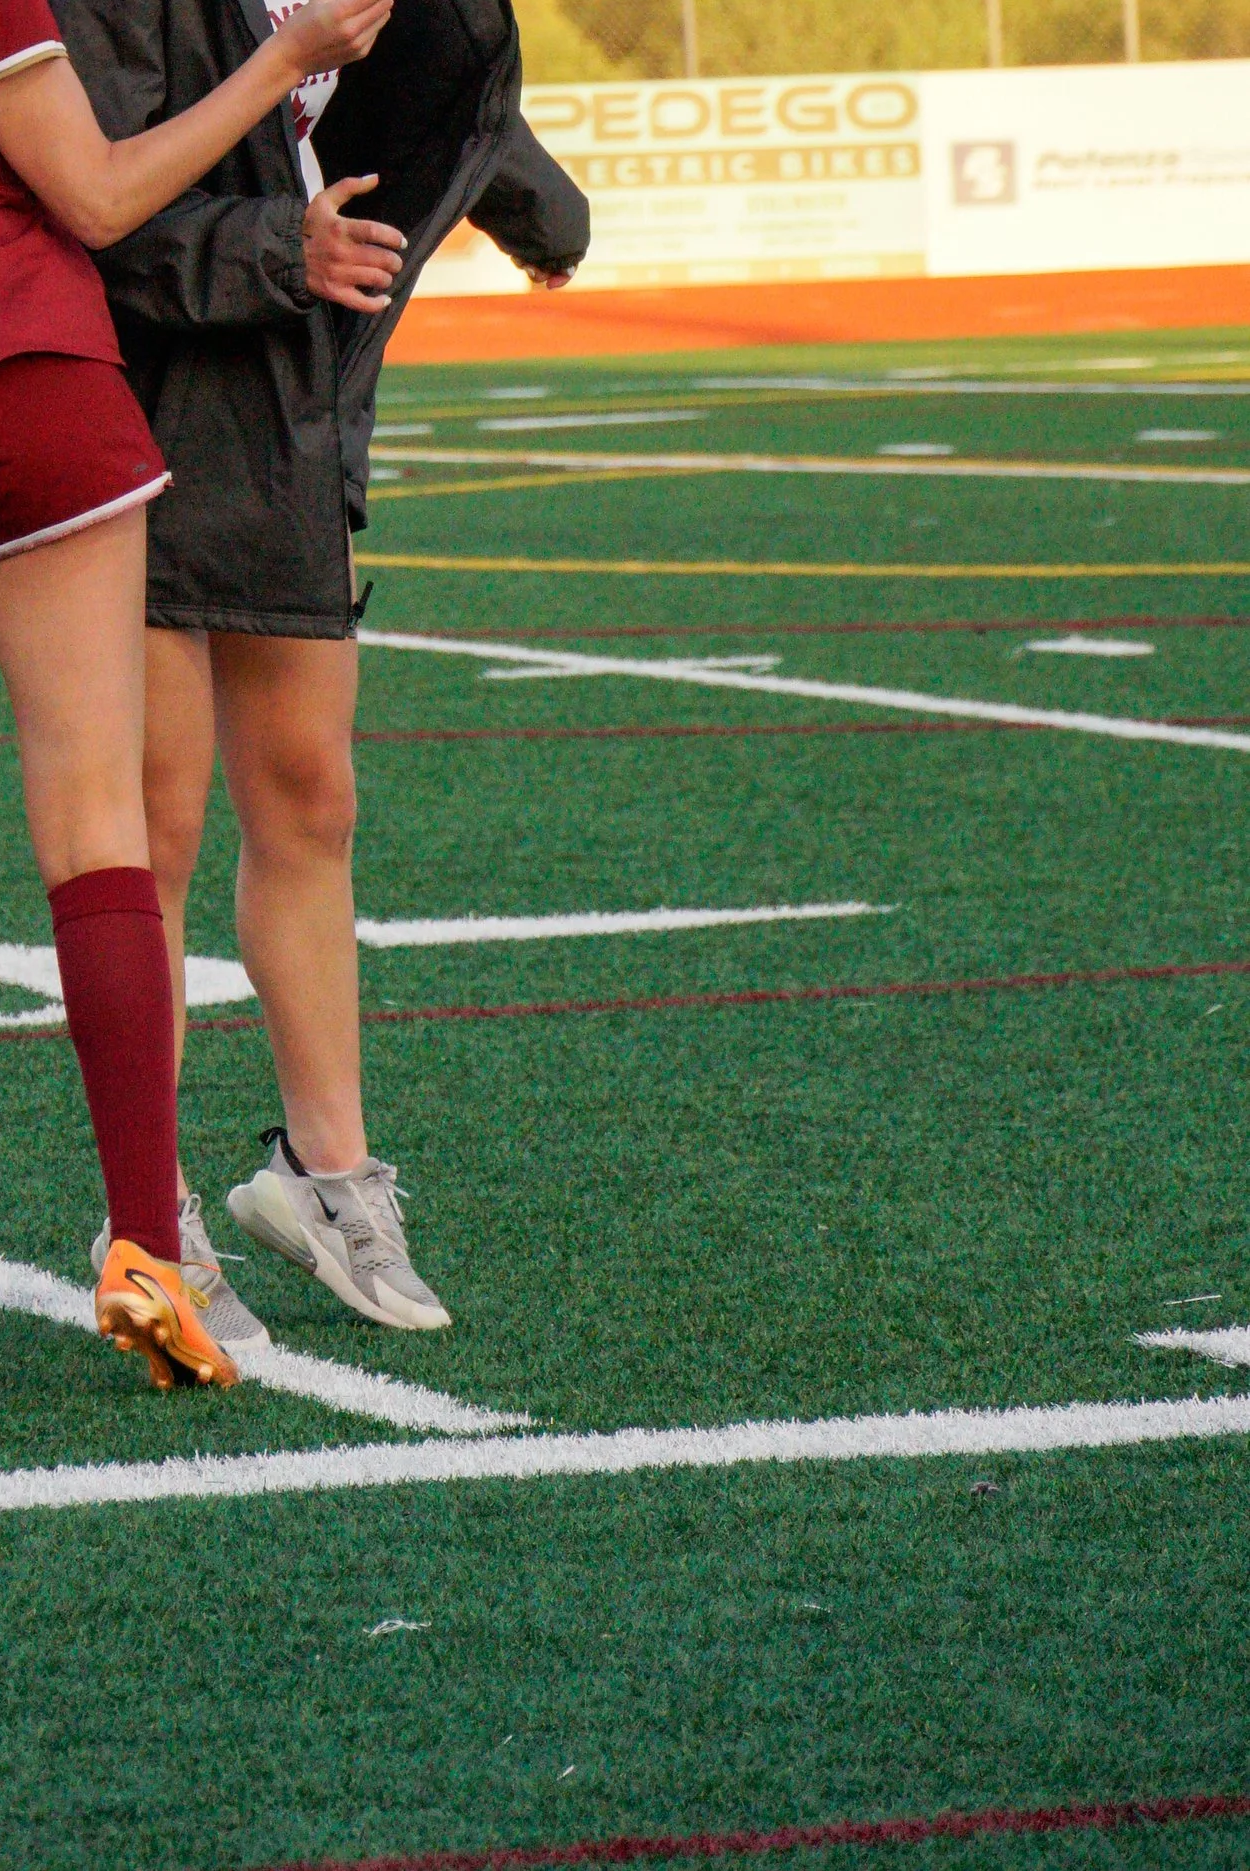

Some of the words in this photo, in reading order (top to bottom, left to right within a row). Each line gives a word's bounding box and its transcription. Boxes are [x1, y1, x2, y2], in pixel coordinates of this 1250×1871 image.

[525, 82, 919, 141] PEDEGO
[561, 153, 756, 188] LECTRIC
[779, 147, 915, 179] BIKES
